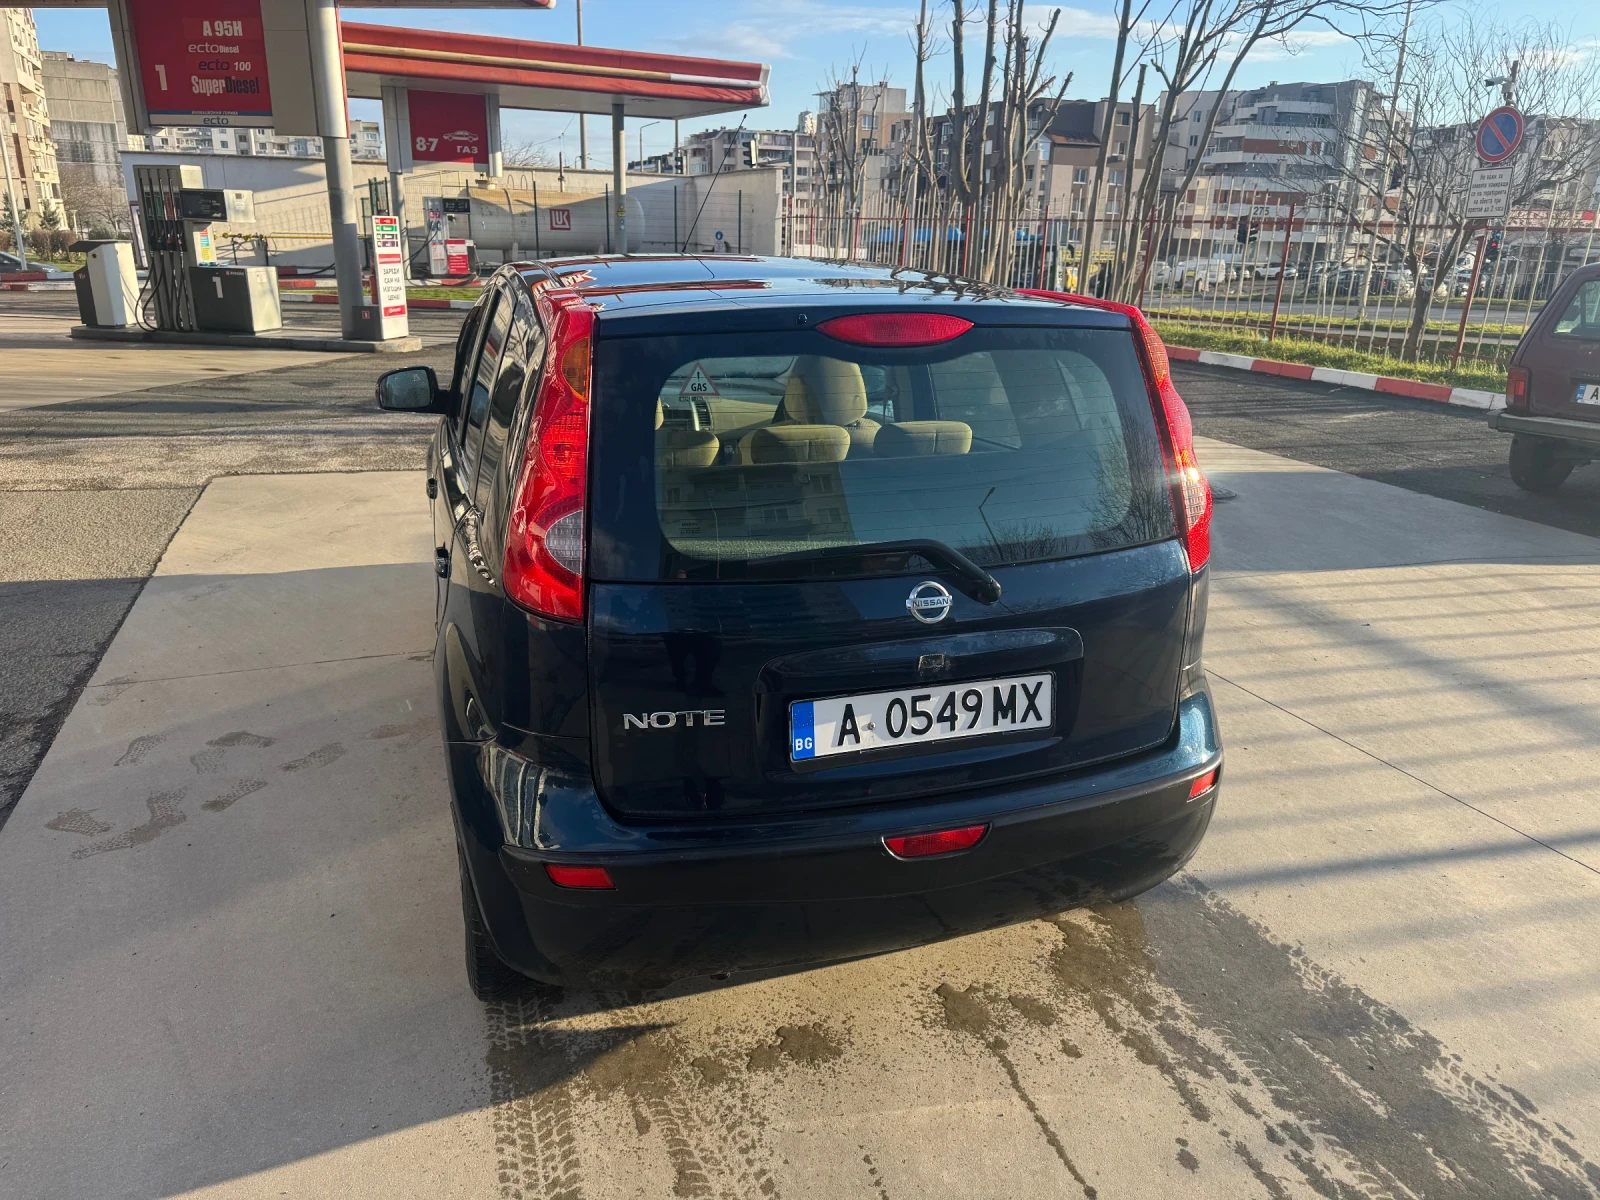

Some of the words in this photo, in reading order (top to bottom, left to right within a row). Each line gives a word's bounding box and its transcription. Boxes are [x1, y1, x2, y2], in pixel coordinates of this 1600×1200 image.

[214, 20, 243, 36] 95H
[198, 58, 230, 71] ecto
[233, 62, 251, 71] 100
[155, 64, 168, 90] 1
[203, 116, 229, 125] ecto
[416, 136, 439, 152] 8-7
[456, 145, 479, 154] ГАЗ
[1253, 206, 1270, 216] 275
[212, 276, 224, 299] 1
[691, 383, 707, 392] GAS
[912, 597, 949, 608] NISSAN
[623, 709, 726, 730] NOTE
[837, 703, 862, 747] A
[885, 687, 984, 739] 0549
[992, 681, 1044, 727] MX
[795, 737, 813, 751] BG
